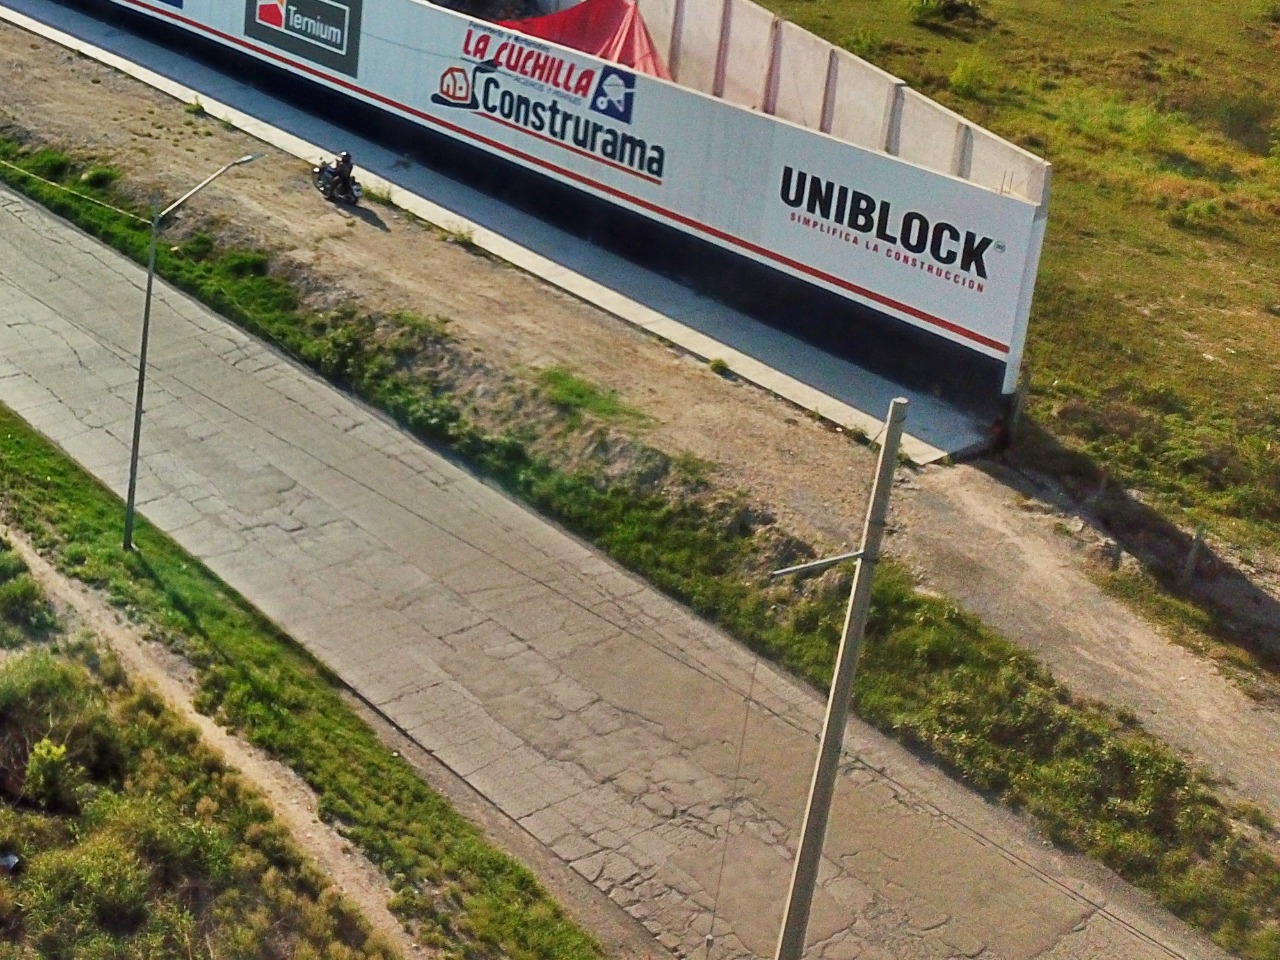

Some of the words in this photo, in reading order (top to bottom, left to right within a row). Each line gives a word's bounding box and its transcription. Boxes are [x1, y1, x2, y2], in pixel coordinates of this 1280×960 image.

[287, 5, 342, 45] Ternium
[463, 29, 491, 60] LA
[494, 41, 596, 98] CUCHILLA
[482, 77, 666, 178] Construrama
[780, 165, 994, 280] UNIBLOCK
[790, 212, 859, 246] SIMPLIFICA
[865, 240, 879, 253] LA
[885, 248, 984, 293] CONSTRUCCION
